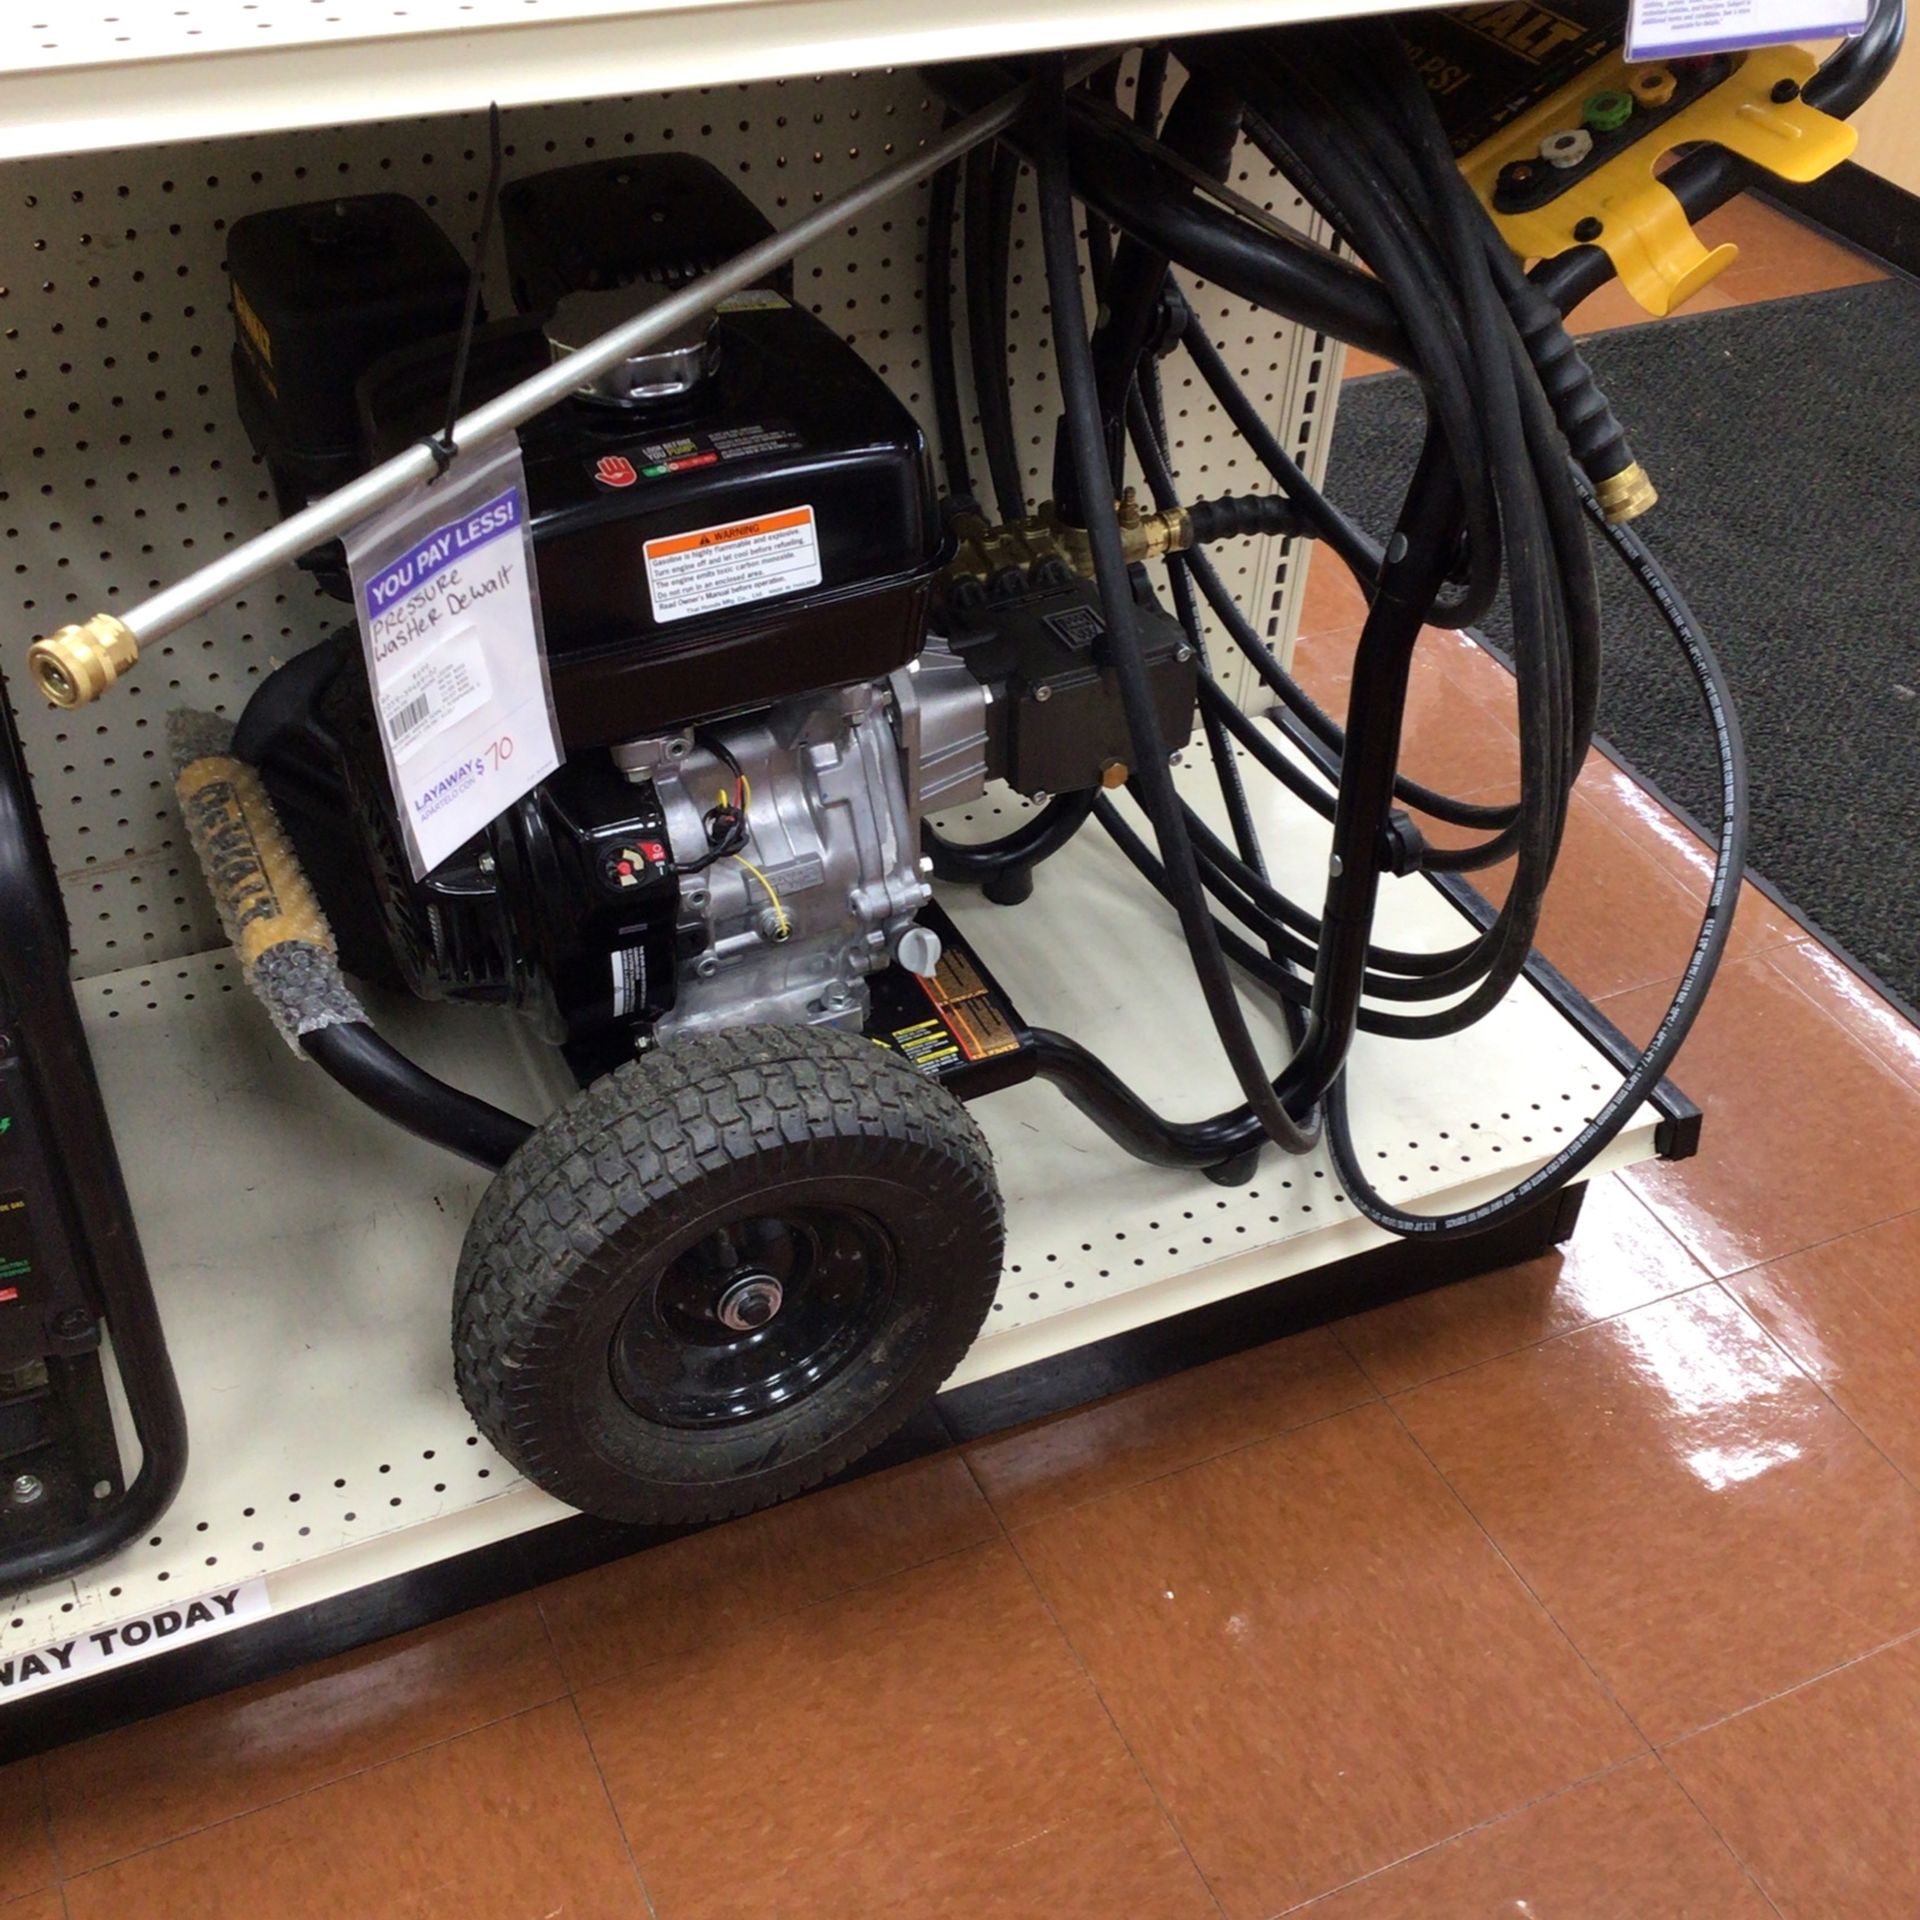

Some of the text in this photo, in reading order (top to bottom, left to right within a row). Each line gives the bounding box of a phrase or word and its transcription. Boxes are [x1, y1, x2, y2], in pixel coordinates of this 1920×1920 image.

[714, 524, 760, 541] WARNING
[373, 501, 514, 604] YOU PAY LESS!
[652, 555, 682, 567] Gasoline
[692, 548, 713, 559] highly
[753, 536, 765, 544] and
[654, 568, 670, 577] Turn
[671, 562, 695, 574] engine
[708, 556, 722, 565] and
[734, 550, 749, 559] cool
[750, 545, 772, 555] before
[656, 581, 669, 589] The
[671, 575, 695, 587] engine
[717, 566, 733, 575] toxic
[735, 560, 760, 571] carbon
[657, 591, 668, 599] Do
[682, 585, 694, 593] run
[659, 601, 676, 610] Read
[705, 589, 730, 600] Manual
[730, 583, 752, 594] before
[414, 759, 473, 812] LAYAWAY
[91, 1588, 240, 1656] TODAY
